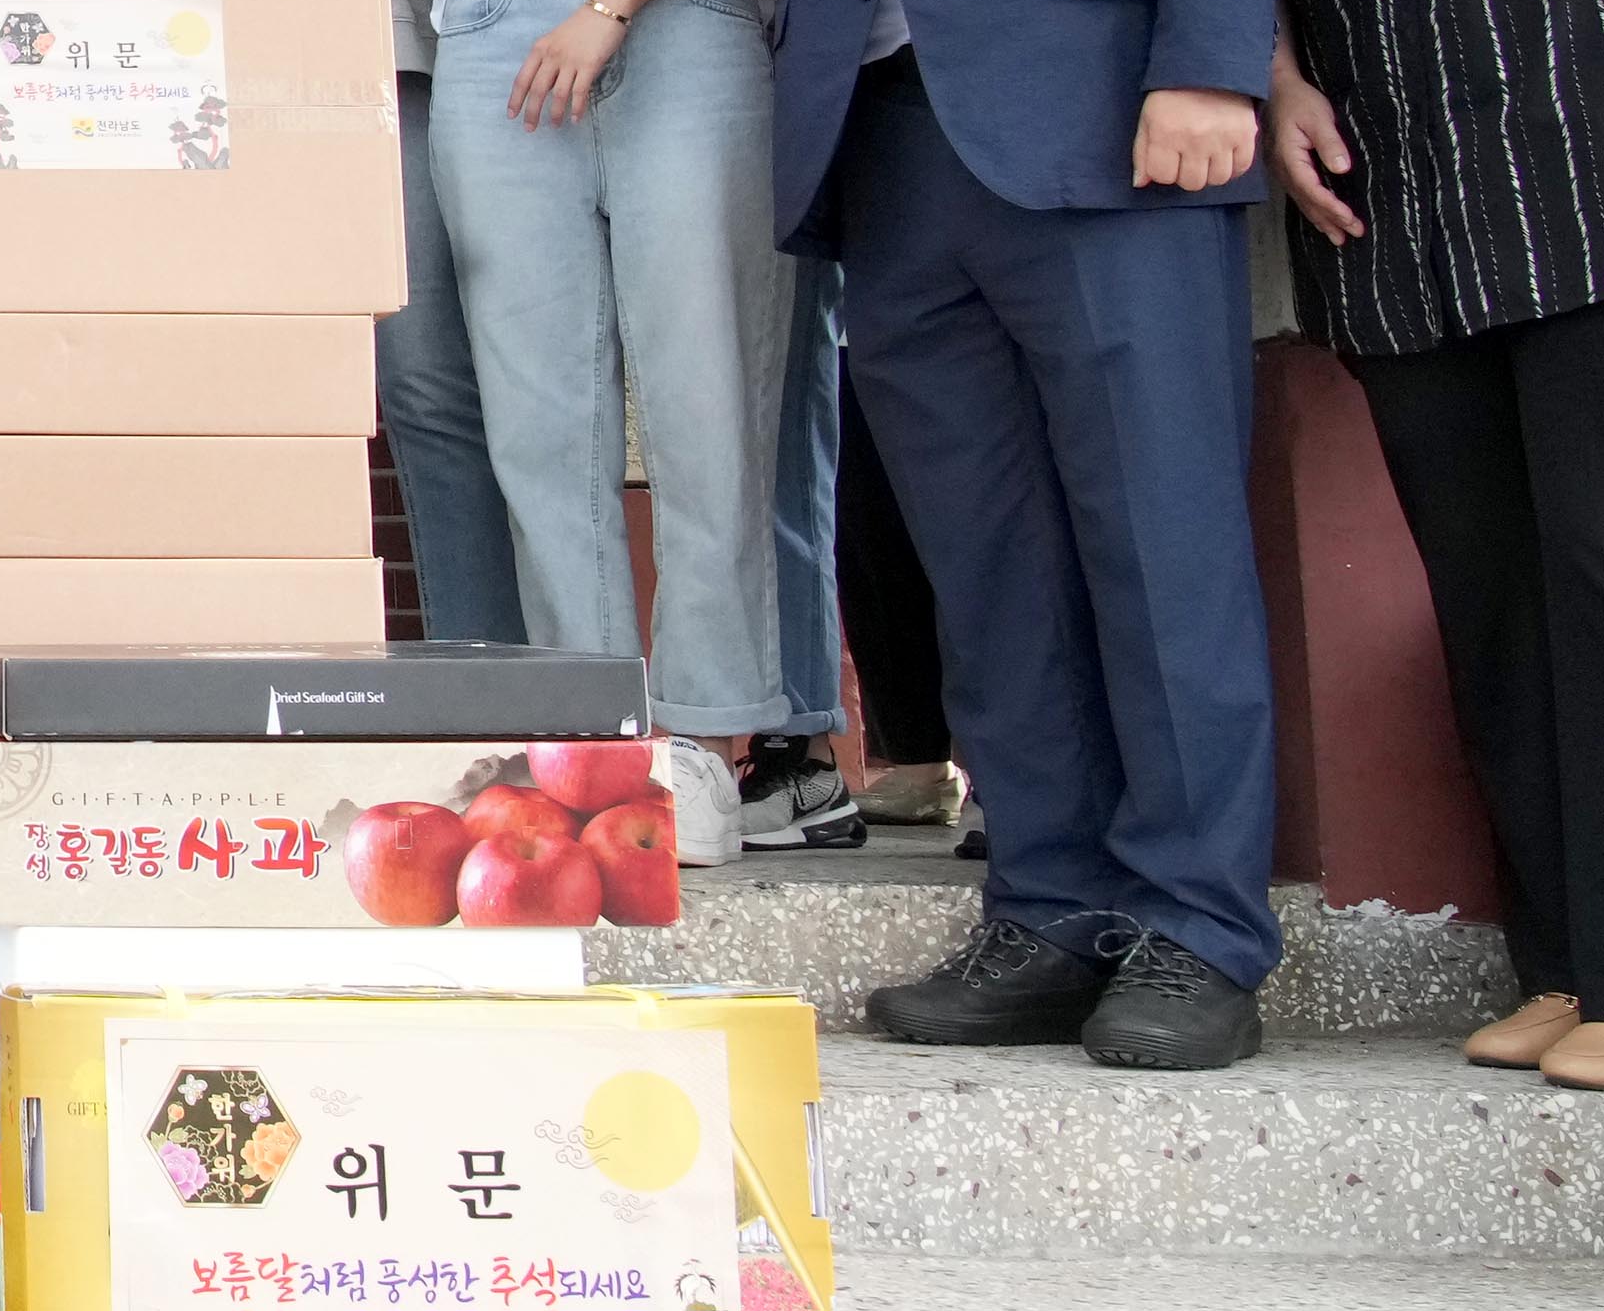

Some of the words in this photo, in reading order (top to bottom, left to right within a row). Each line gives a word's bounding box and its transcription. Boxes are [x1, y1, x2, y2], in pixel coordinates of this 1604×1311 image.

[13, 83, 81, 102] 보름달처럼
[85, 84, 123, 101] 풍성한
[128, 82, 191, 101] 추석되세요
[96, 119, 141, 132] 전라남도
[272, 691, 302, 704] Dried
[303, 691, 345, 703] Seafood
[346, 691, 365, 703] Gift
[367, 691, 385, 703] Set
[54, 822, 169, 880] 홍길동
[176, 816, 332, 881] 사과
[66, 1101, 100, 1116] GIFT
[208, 1092, 237, 1182] 한가위
[192, 1250, 366, 1308] 보름달처럼
[378, 1257, 480, 1305] 풍성한
[488, 1252, 652, 1305] 추석되세요
